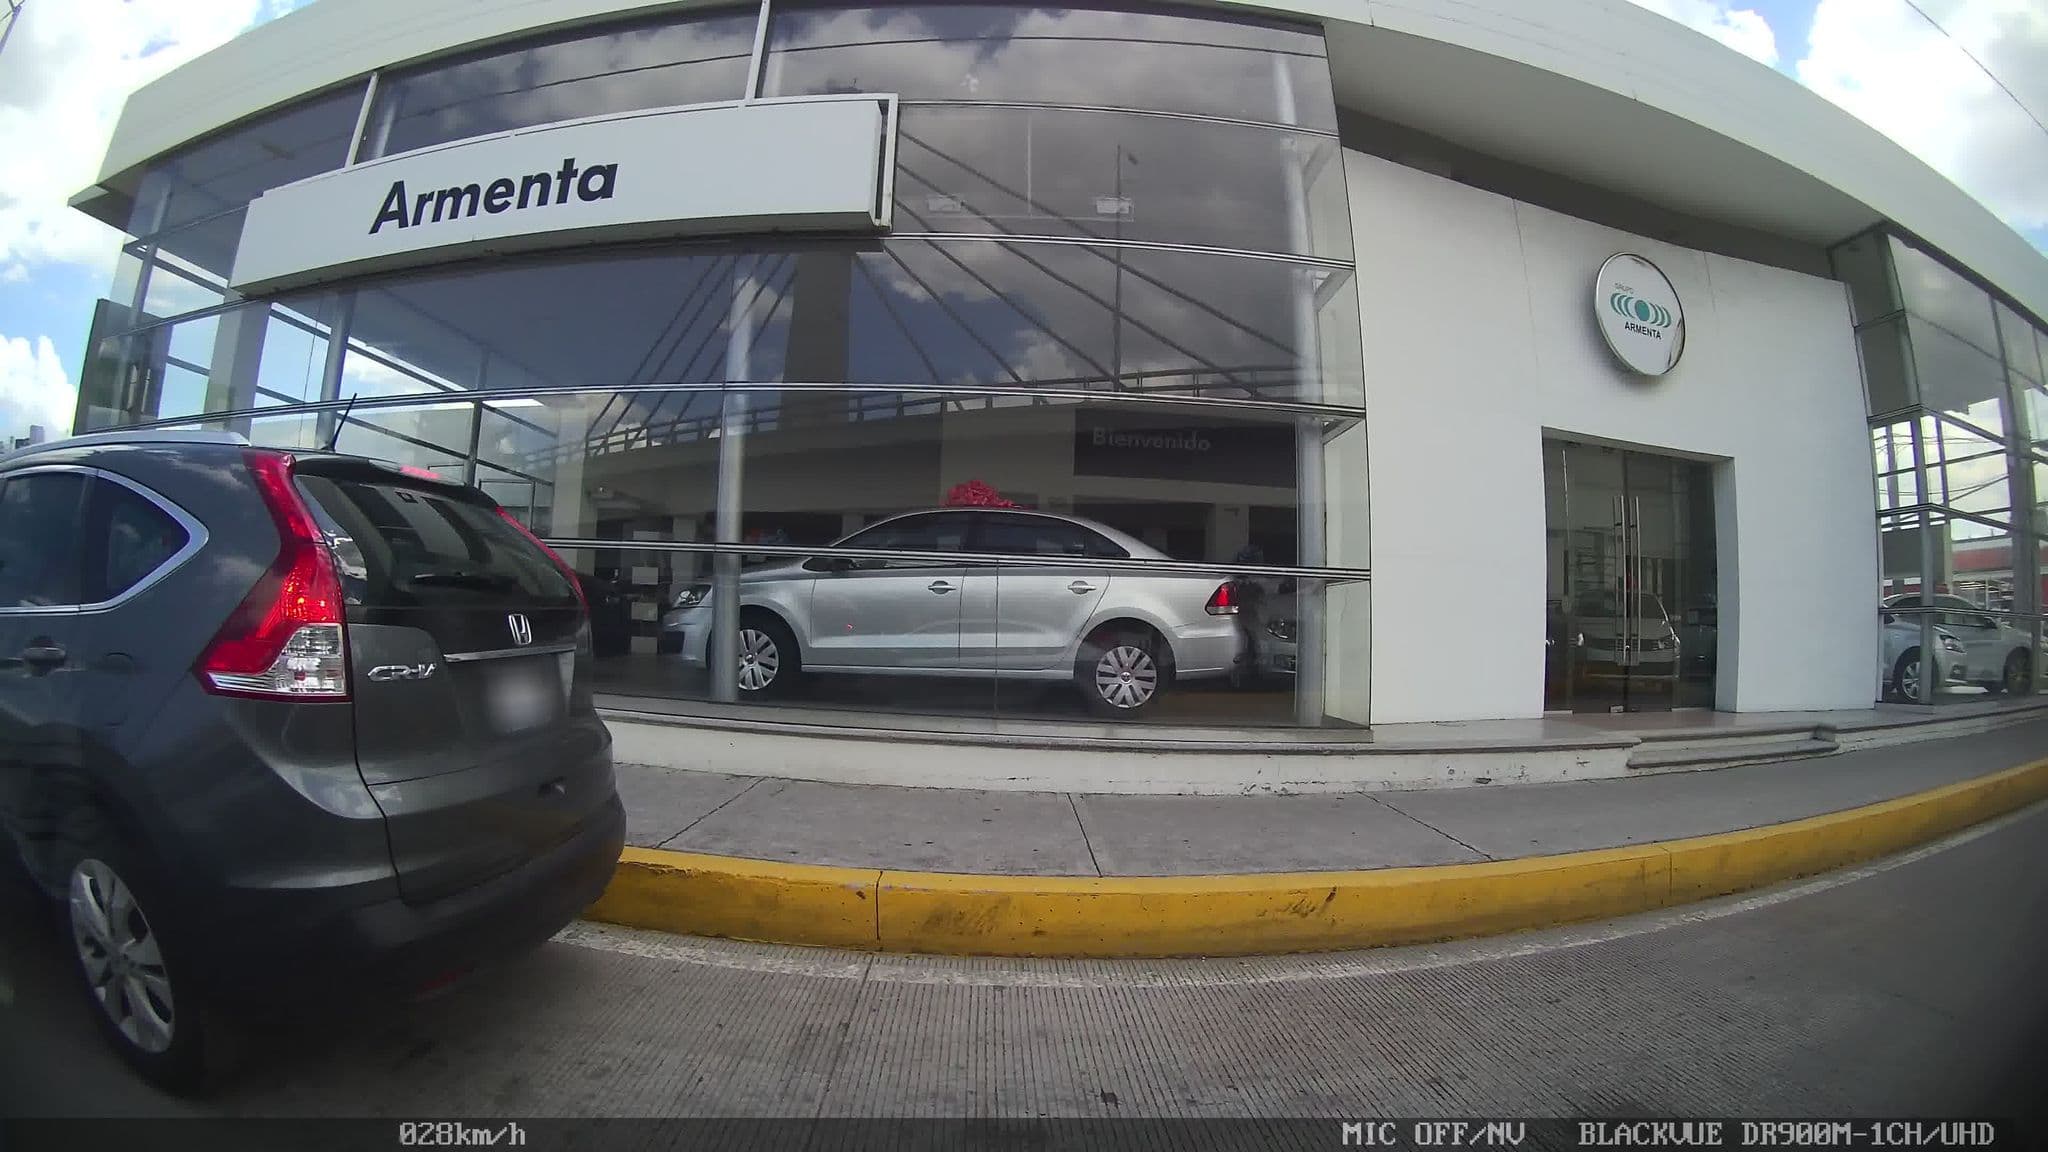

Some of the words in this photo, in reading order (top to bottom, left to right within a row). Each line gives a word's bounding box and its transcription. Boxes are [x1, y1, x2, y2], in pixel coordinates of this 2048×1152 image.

[368, 157, 618, 234] Armenta
[1624, 321, 1662, 340] ARMENTA
[1092, 426, 1211, 451] Bienvenido
